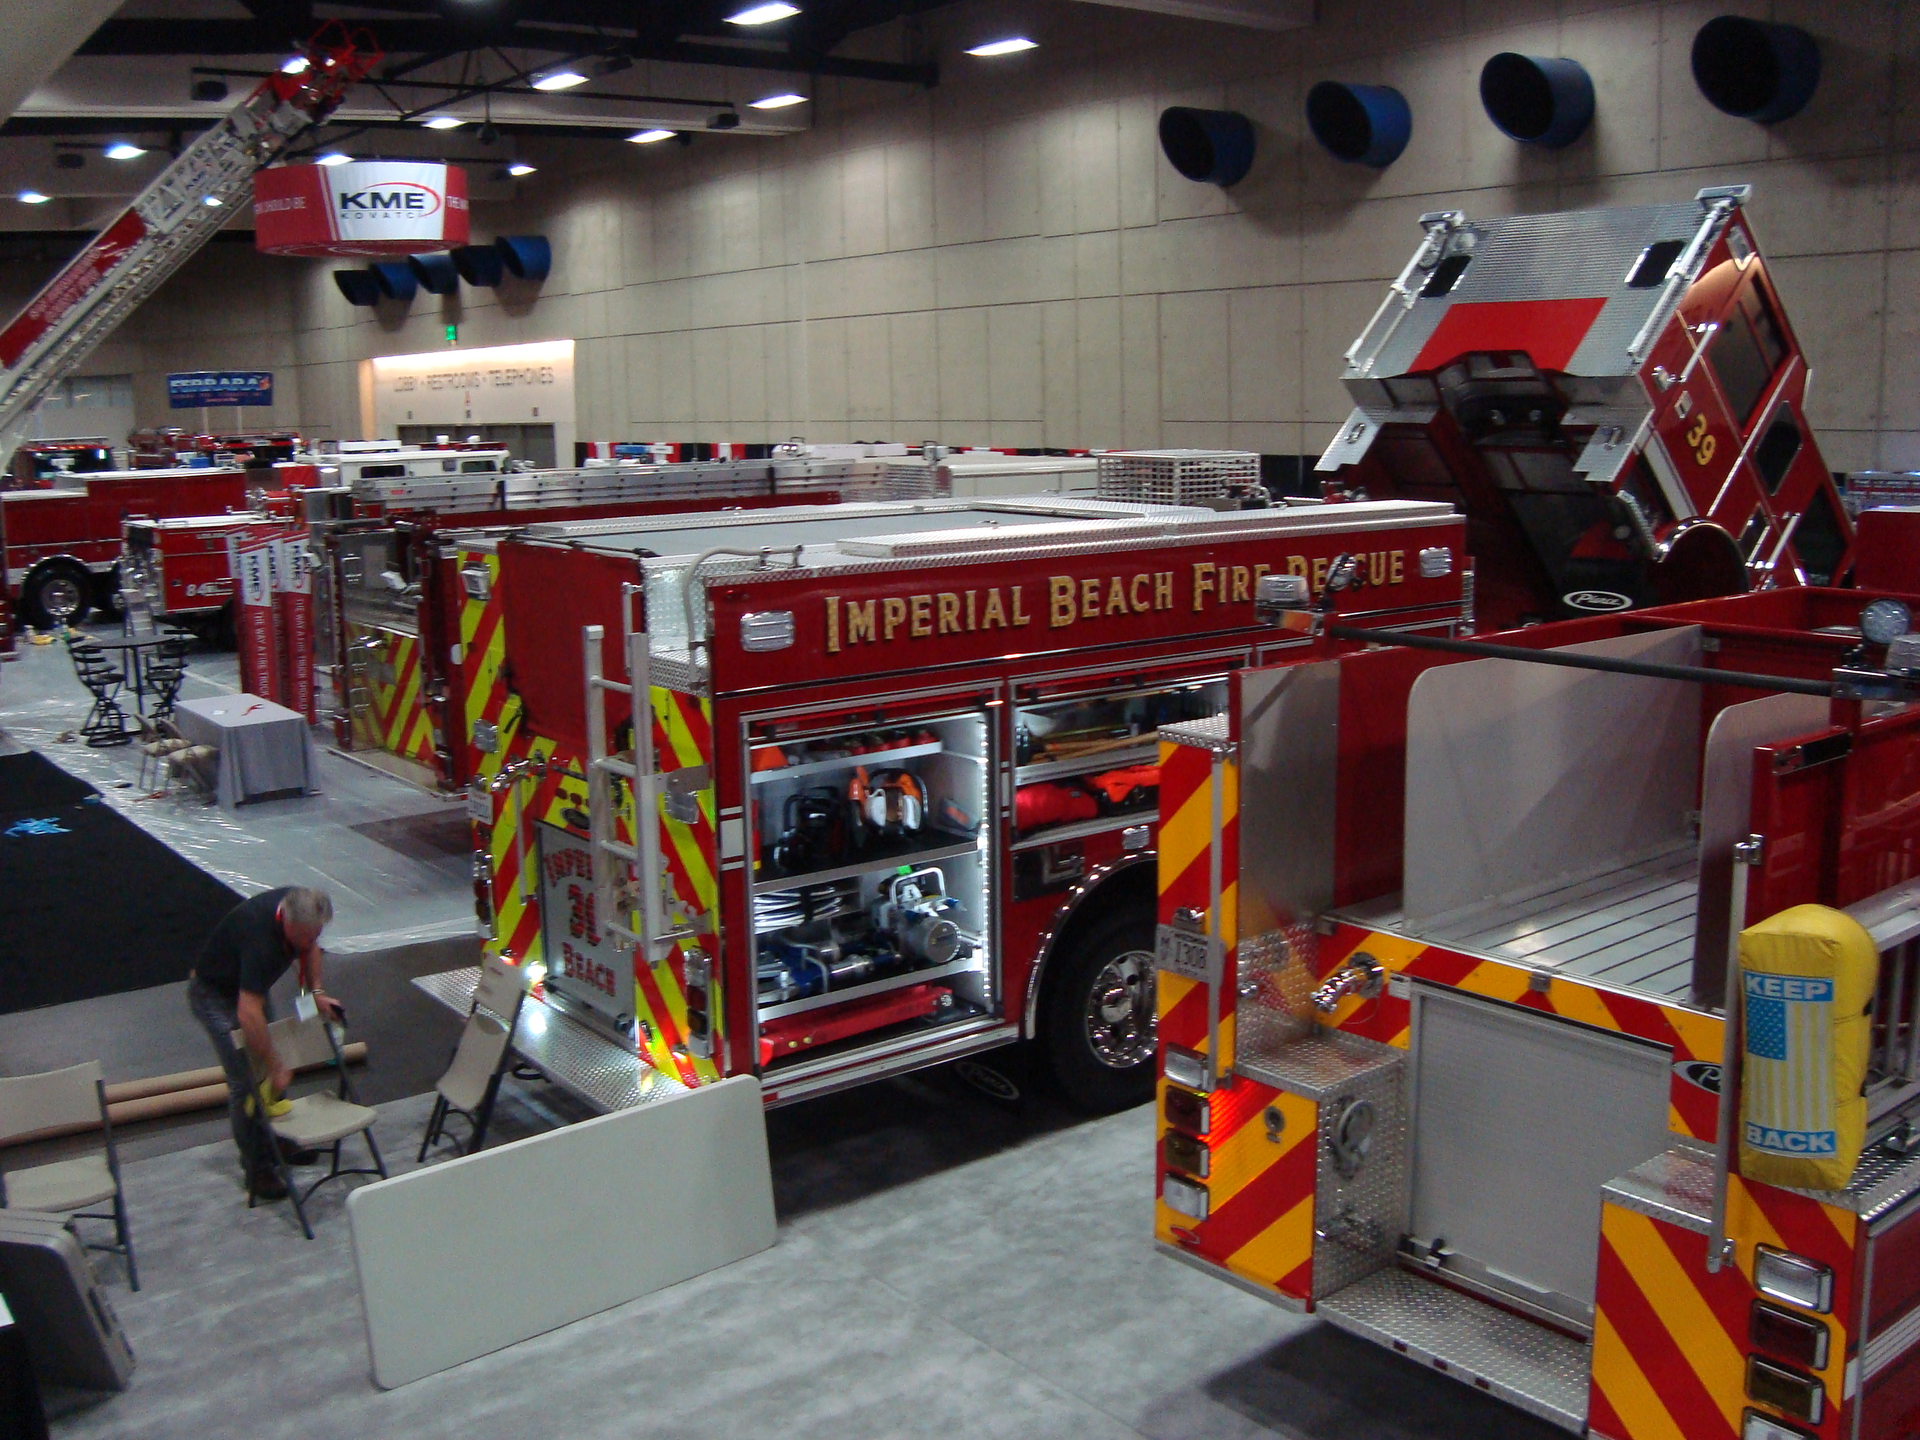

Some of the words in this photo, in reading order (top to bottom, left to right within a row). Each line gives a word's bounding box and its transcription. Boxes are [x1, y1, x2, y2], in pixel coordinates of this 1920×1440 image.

[340, 192, 425, 210] KME
[1685, 412, 1717, 466] 39
[250, 554, 261, 594] KME
[254, 611, 265, 625] THE
[296, 613, 306, 629] WAY
[824, 585, 1031, 653] IMPERIAL
[1048, 571, 1174, 628] BEACH
[255, 627, 267, 644] WAY
[1745, 973, 1829, 1000] KEEP
[1746, 1124, 1834, 1152] BACK
